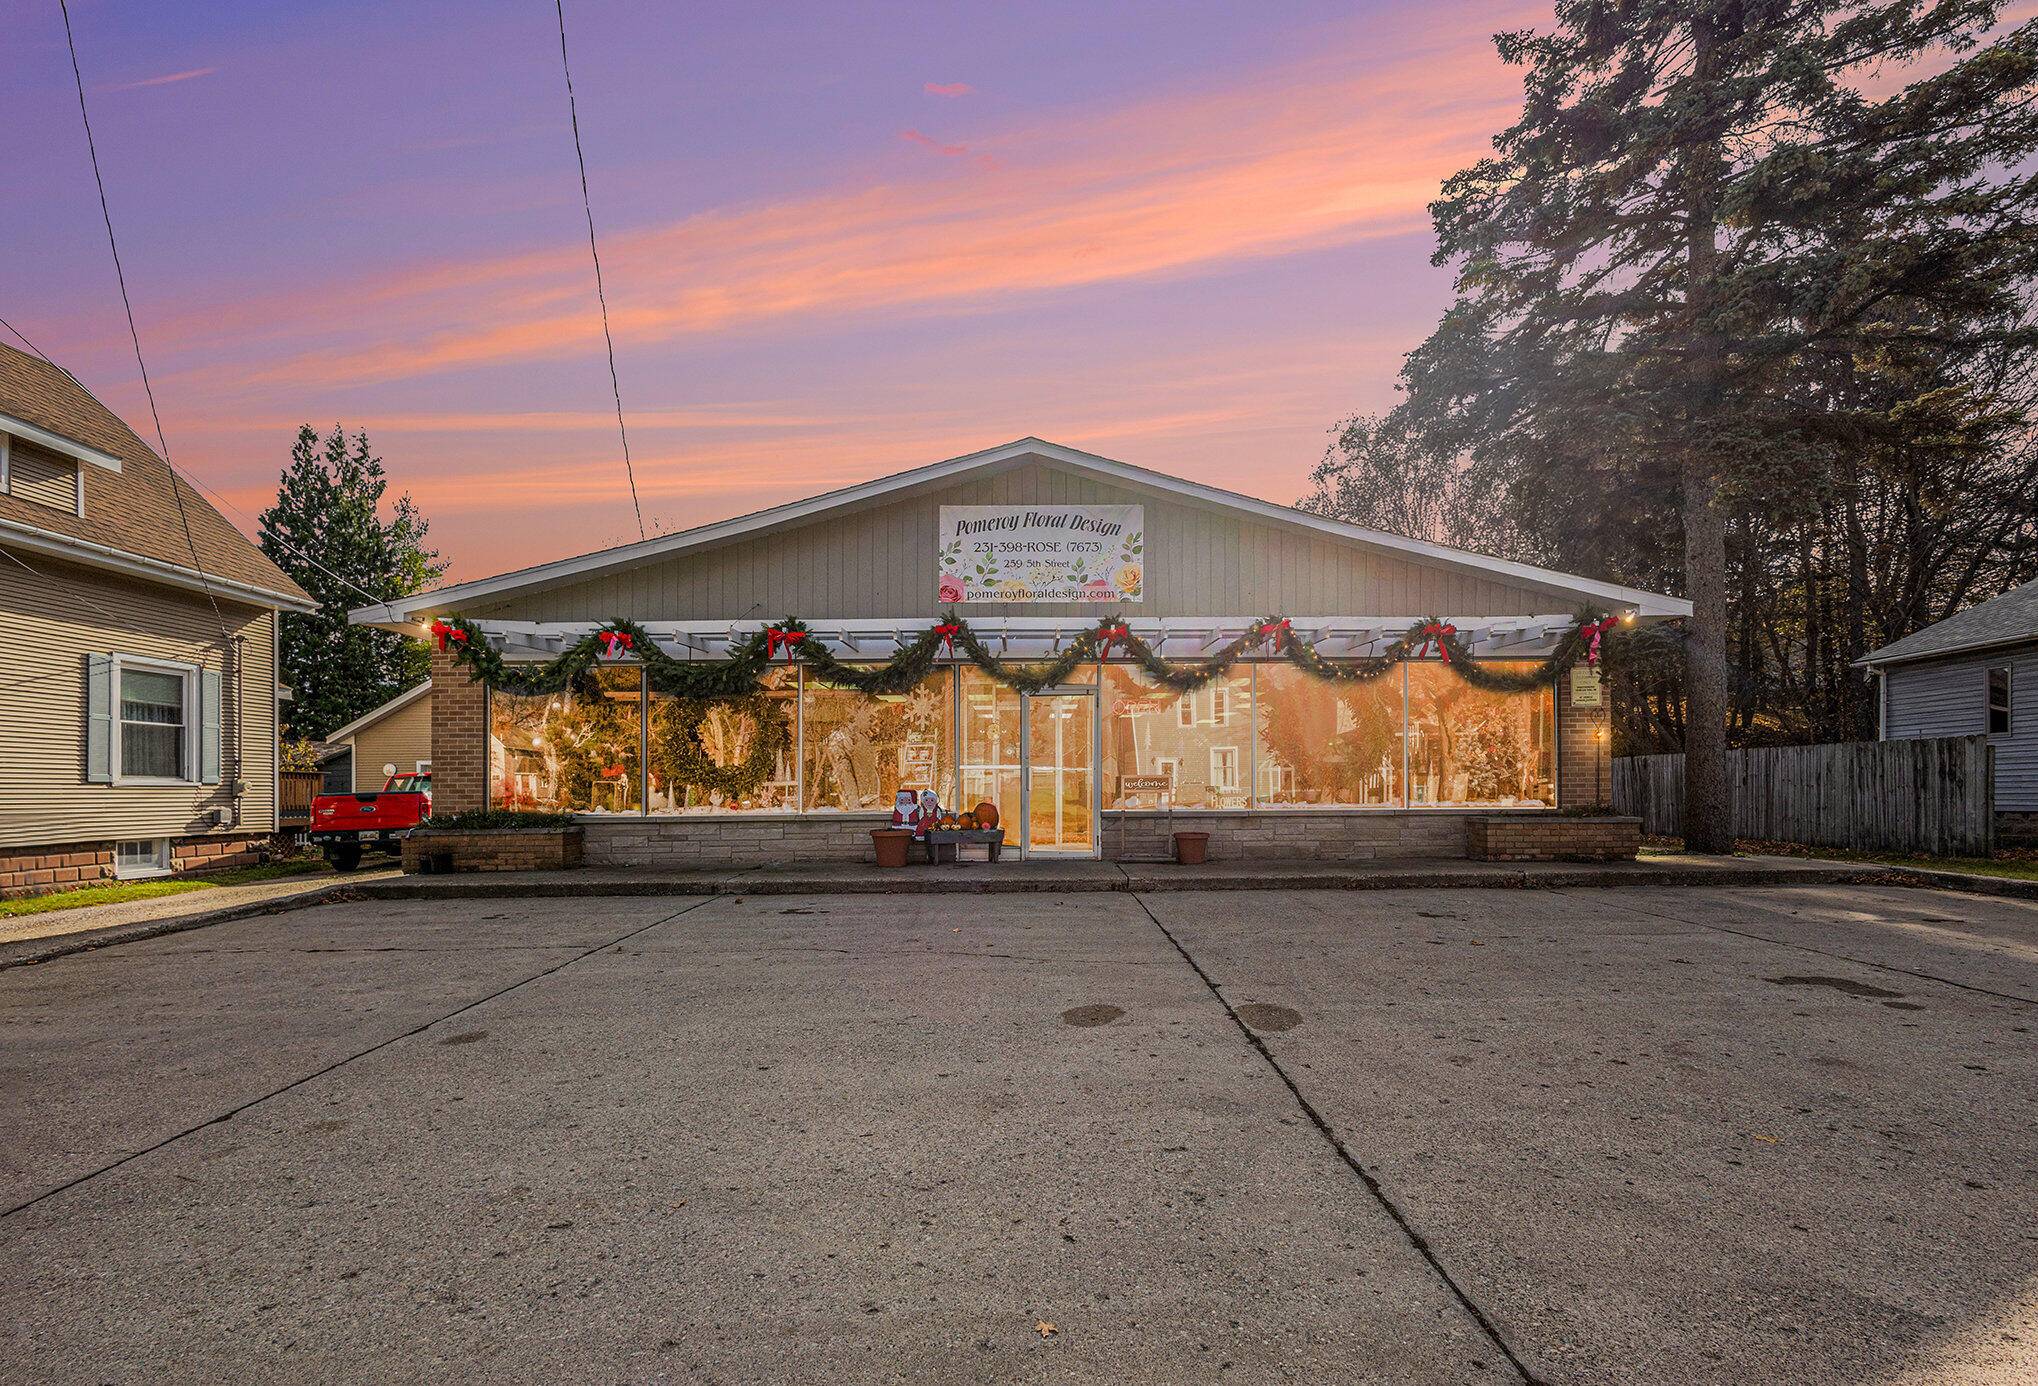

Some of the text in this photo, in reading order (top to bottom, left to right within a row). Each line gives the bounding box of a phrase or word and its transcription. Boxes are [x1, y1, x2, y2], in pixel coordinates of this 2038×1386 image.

[956, 512, 1122, 537] Pomeroy Floral Design
[973, 541, 1103, 554] 231-398-ROSE (7673)
[1003, 558, 1070, 569] 259 5th Street
[967, 588, 1115, 601] pomeroyfloraldesign.com
[1125, 778, 1168, 789] welcome
